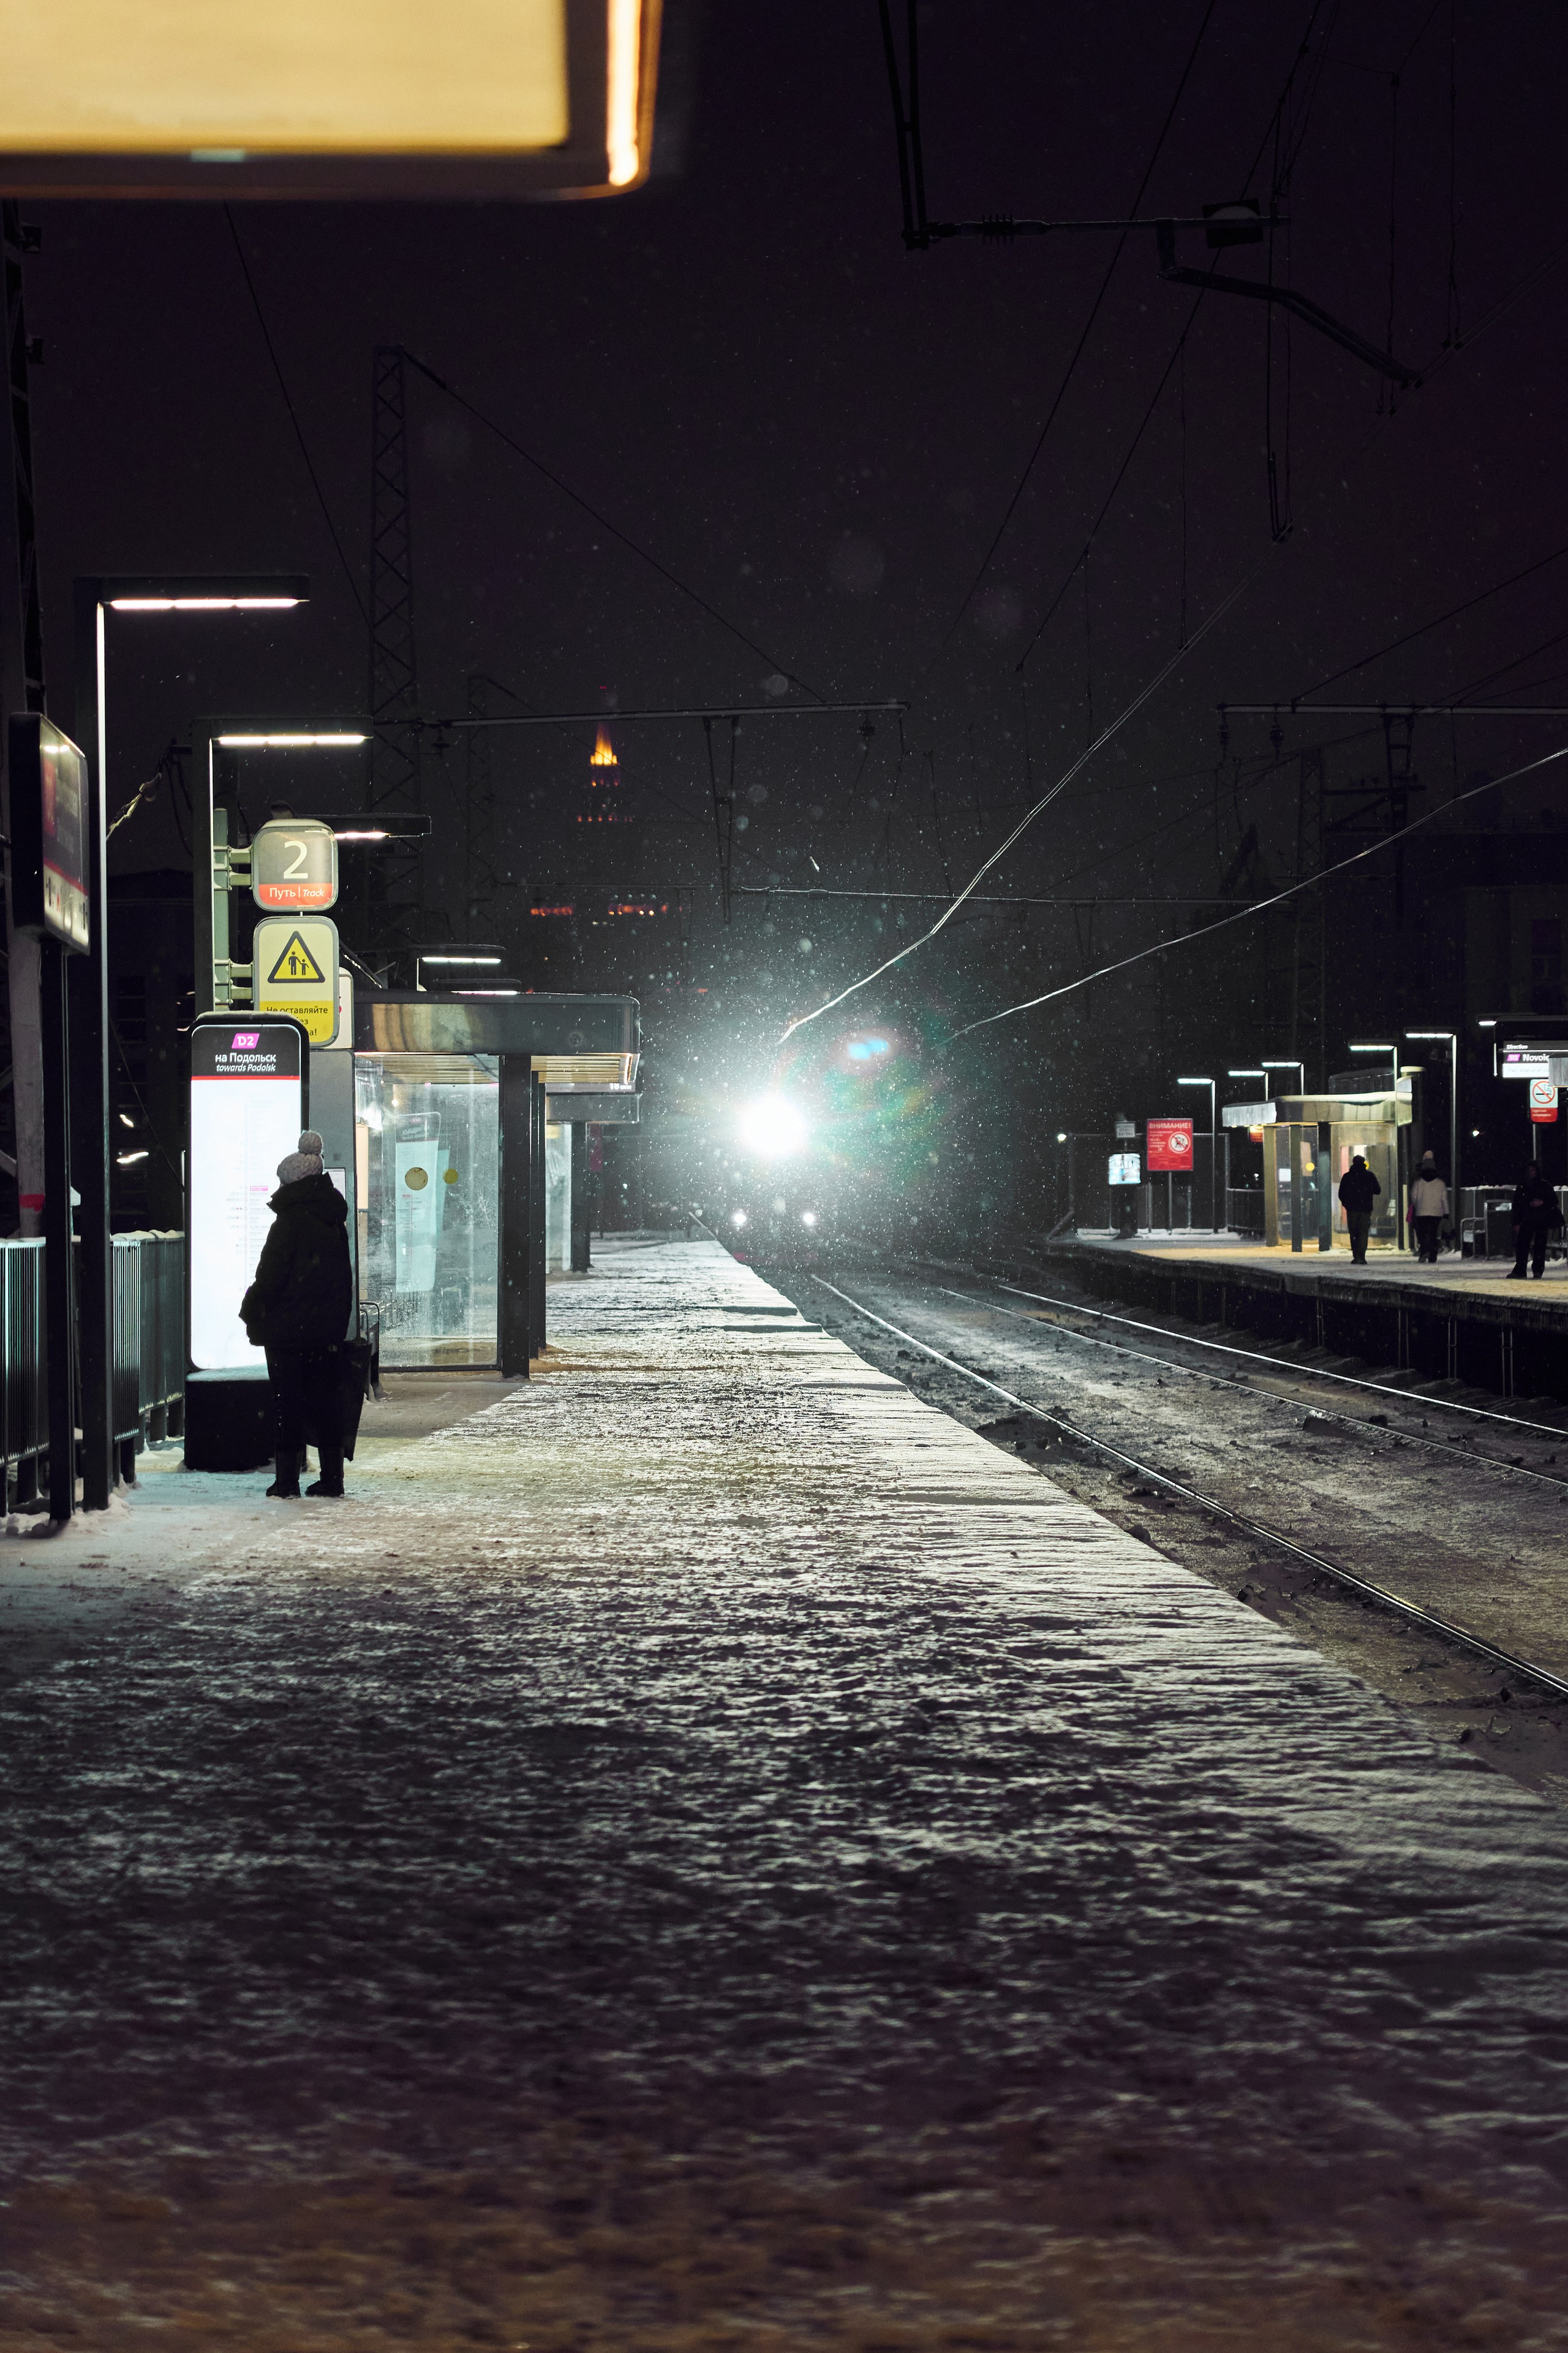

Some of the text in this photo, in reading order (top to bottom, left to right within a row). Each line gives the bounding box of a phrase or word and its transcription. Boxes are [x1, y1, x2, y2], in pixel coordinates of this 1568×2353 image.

[284, 840, 309, 879] 2
[270, 888, 325, 900] Путь Track
[237, 1036, 254, 1046] D2
[230, 1052, 276, 1063] Подольск
[216, 1063, 276, 1072] towards Podolsk
